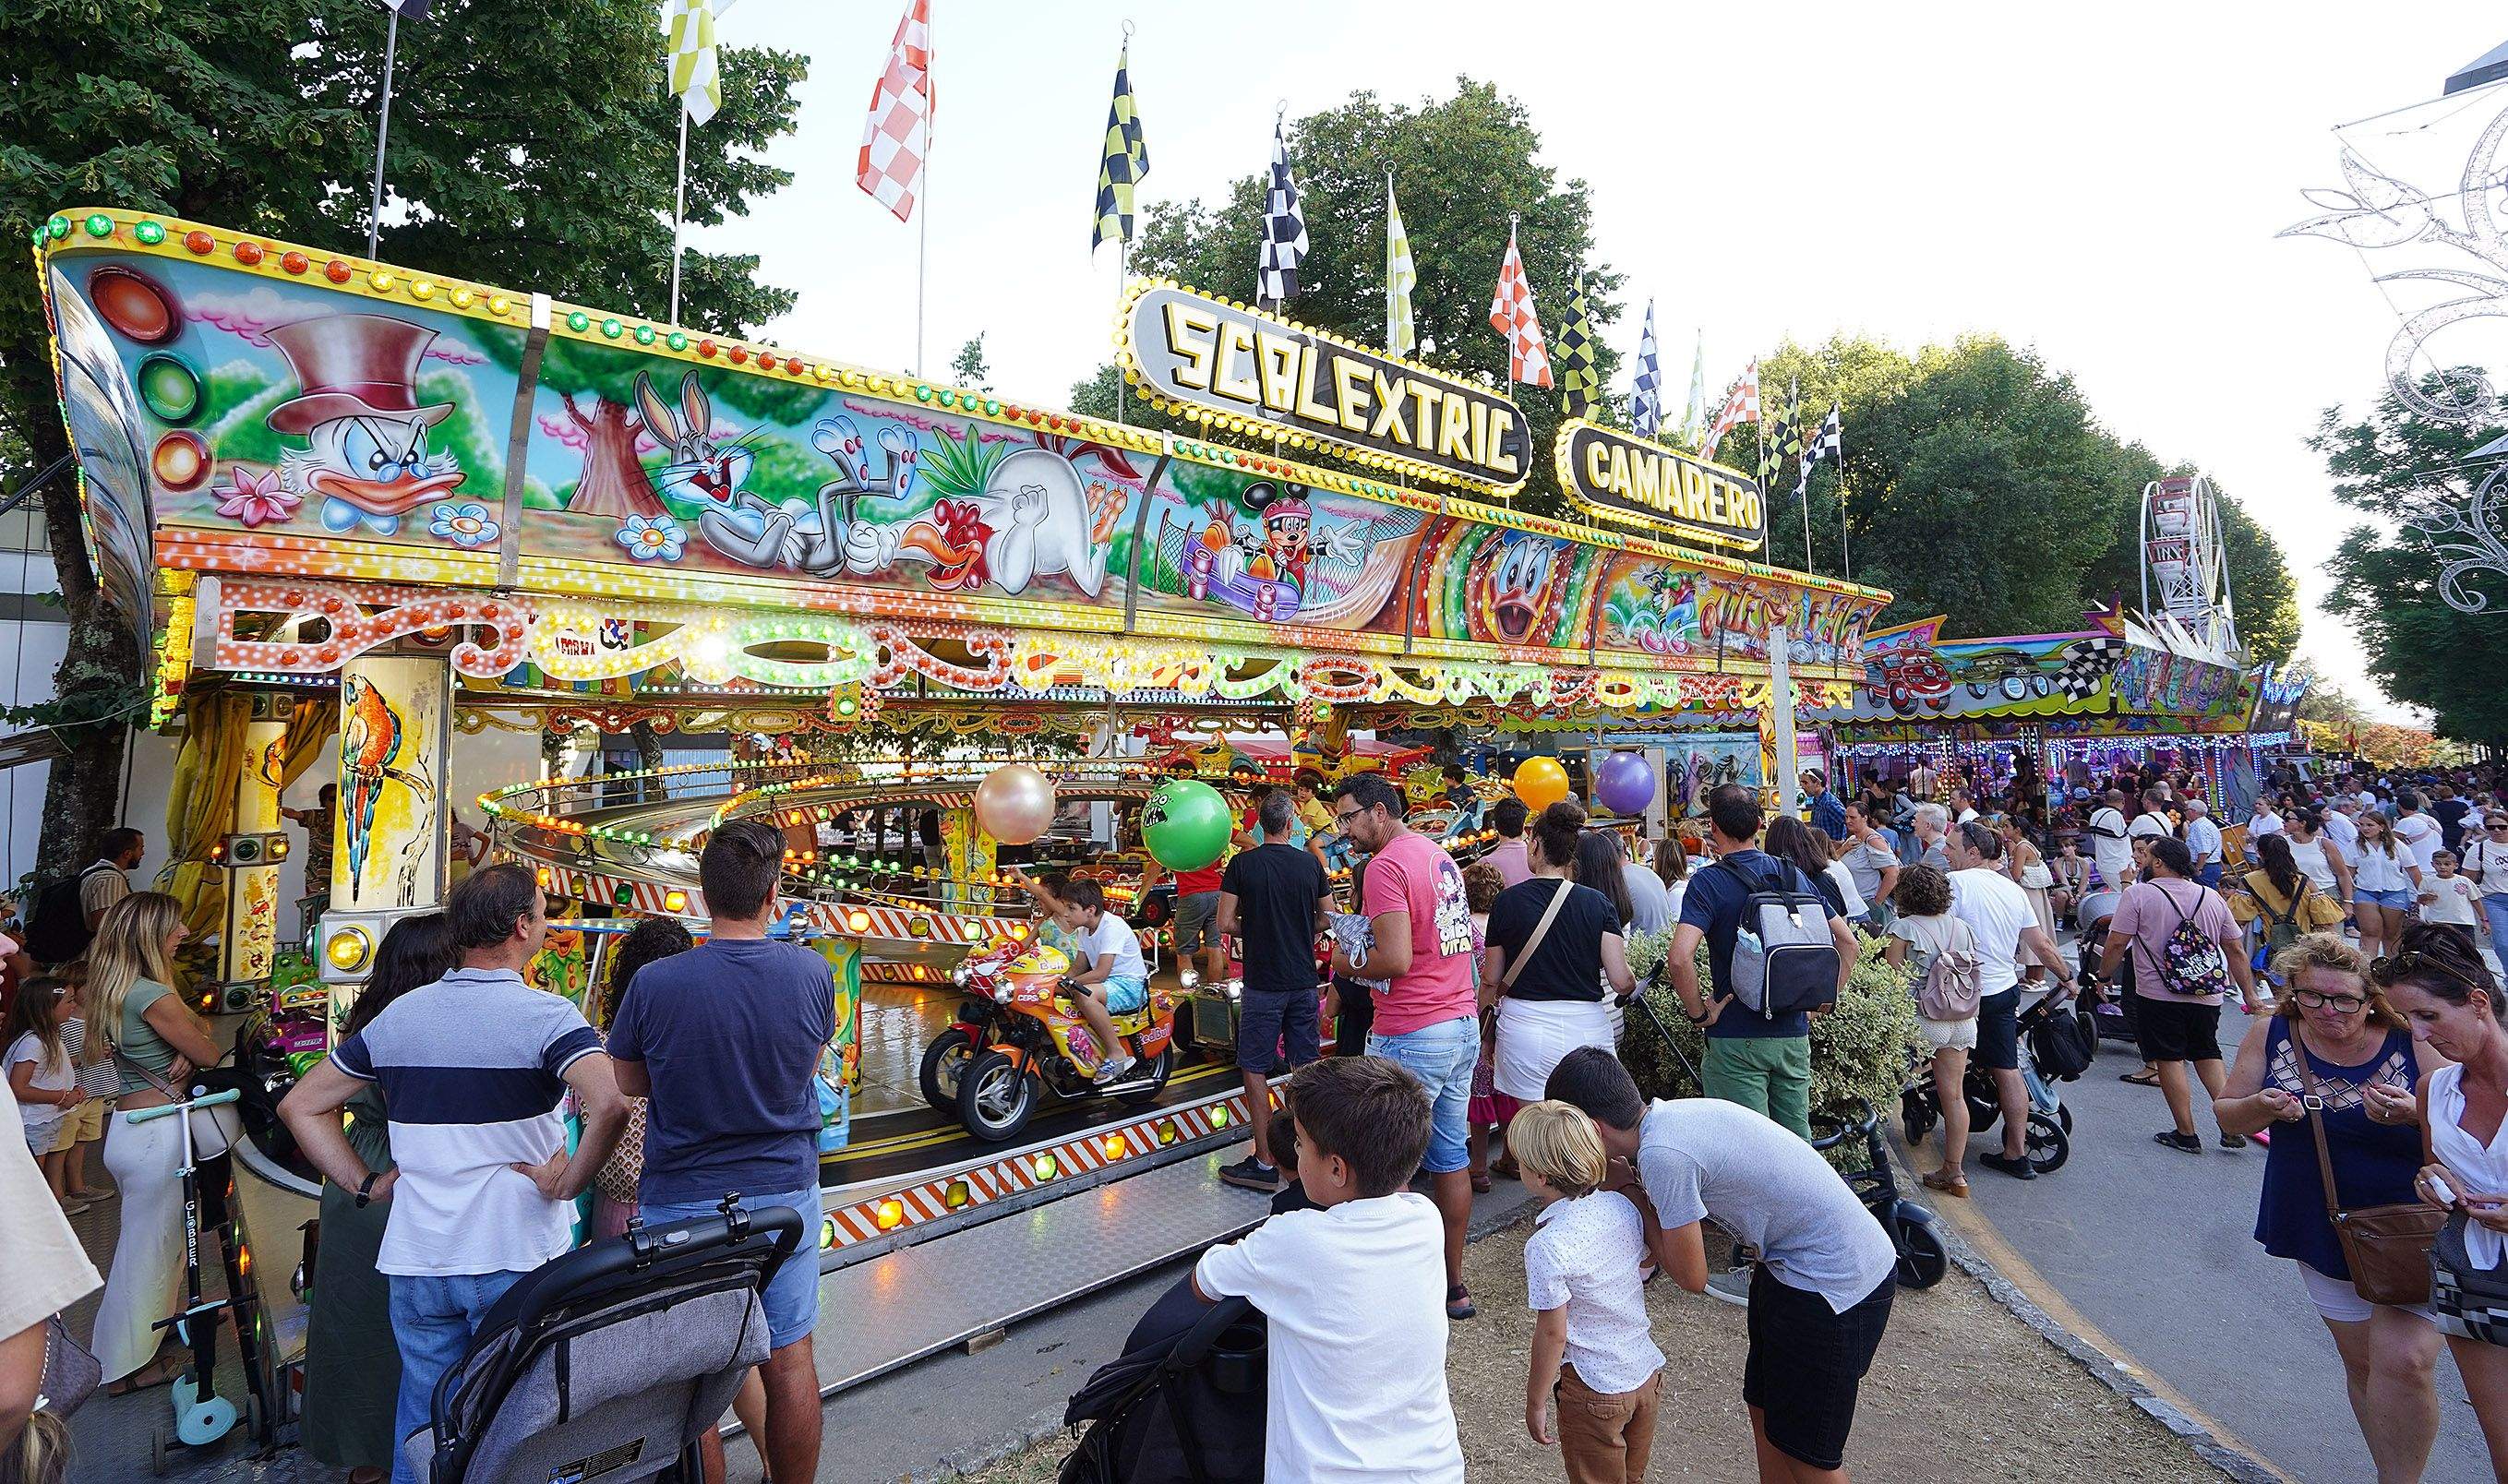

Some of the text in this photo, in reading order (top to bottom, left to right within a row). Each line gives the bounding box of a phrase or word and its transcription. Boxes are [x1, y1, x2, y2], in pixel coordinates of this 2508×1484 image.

[1163, 301, 1518, 474] SCALEXTRIC
[1587, 440, 1761, 531] CAMARERO
[1039, 960, 1064, 970] Bull
[185, 1200, 198, 1267] GLOBBER
